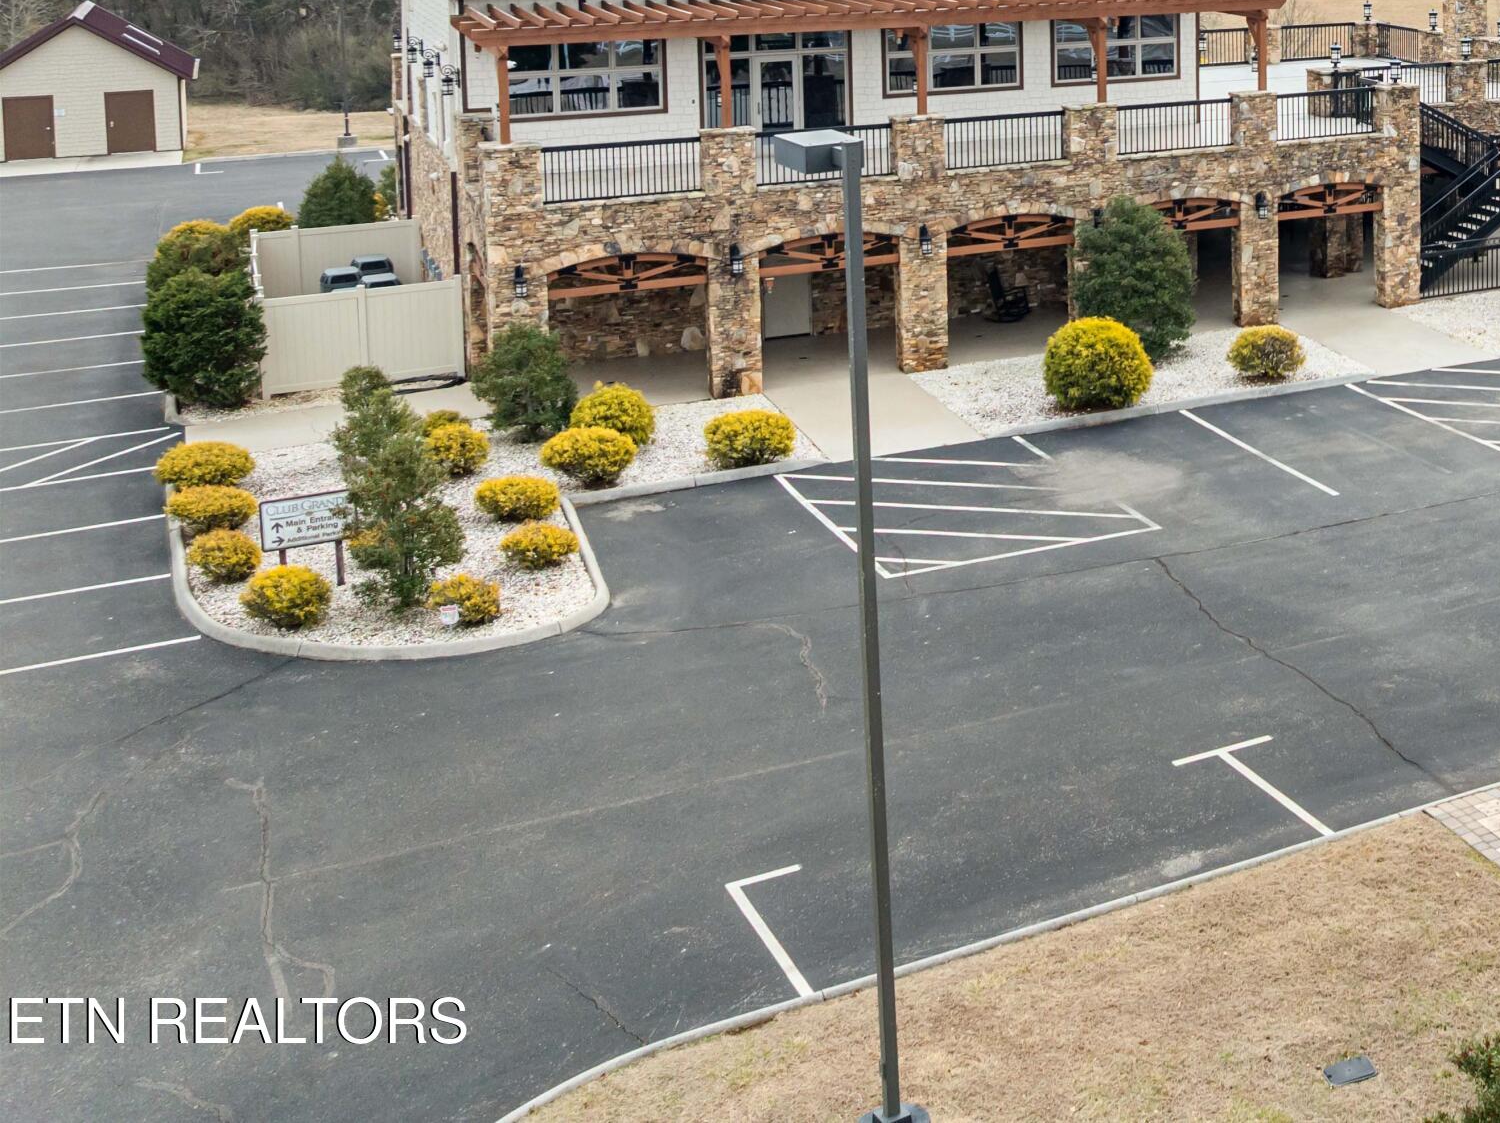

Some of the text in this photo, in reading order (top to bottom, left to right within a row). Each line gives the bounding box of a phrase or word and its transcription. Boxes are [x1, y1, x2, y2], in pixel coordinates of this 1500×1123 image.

[266, 504, 299, 516] CLUB
[286, 519, 306, 527] Main
[306, 521, 339, 532] Parking
